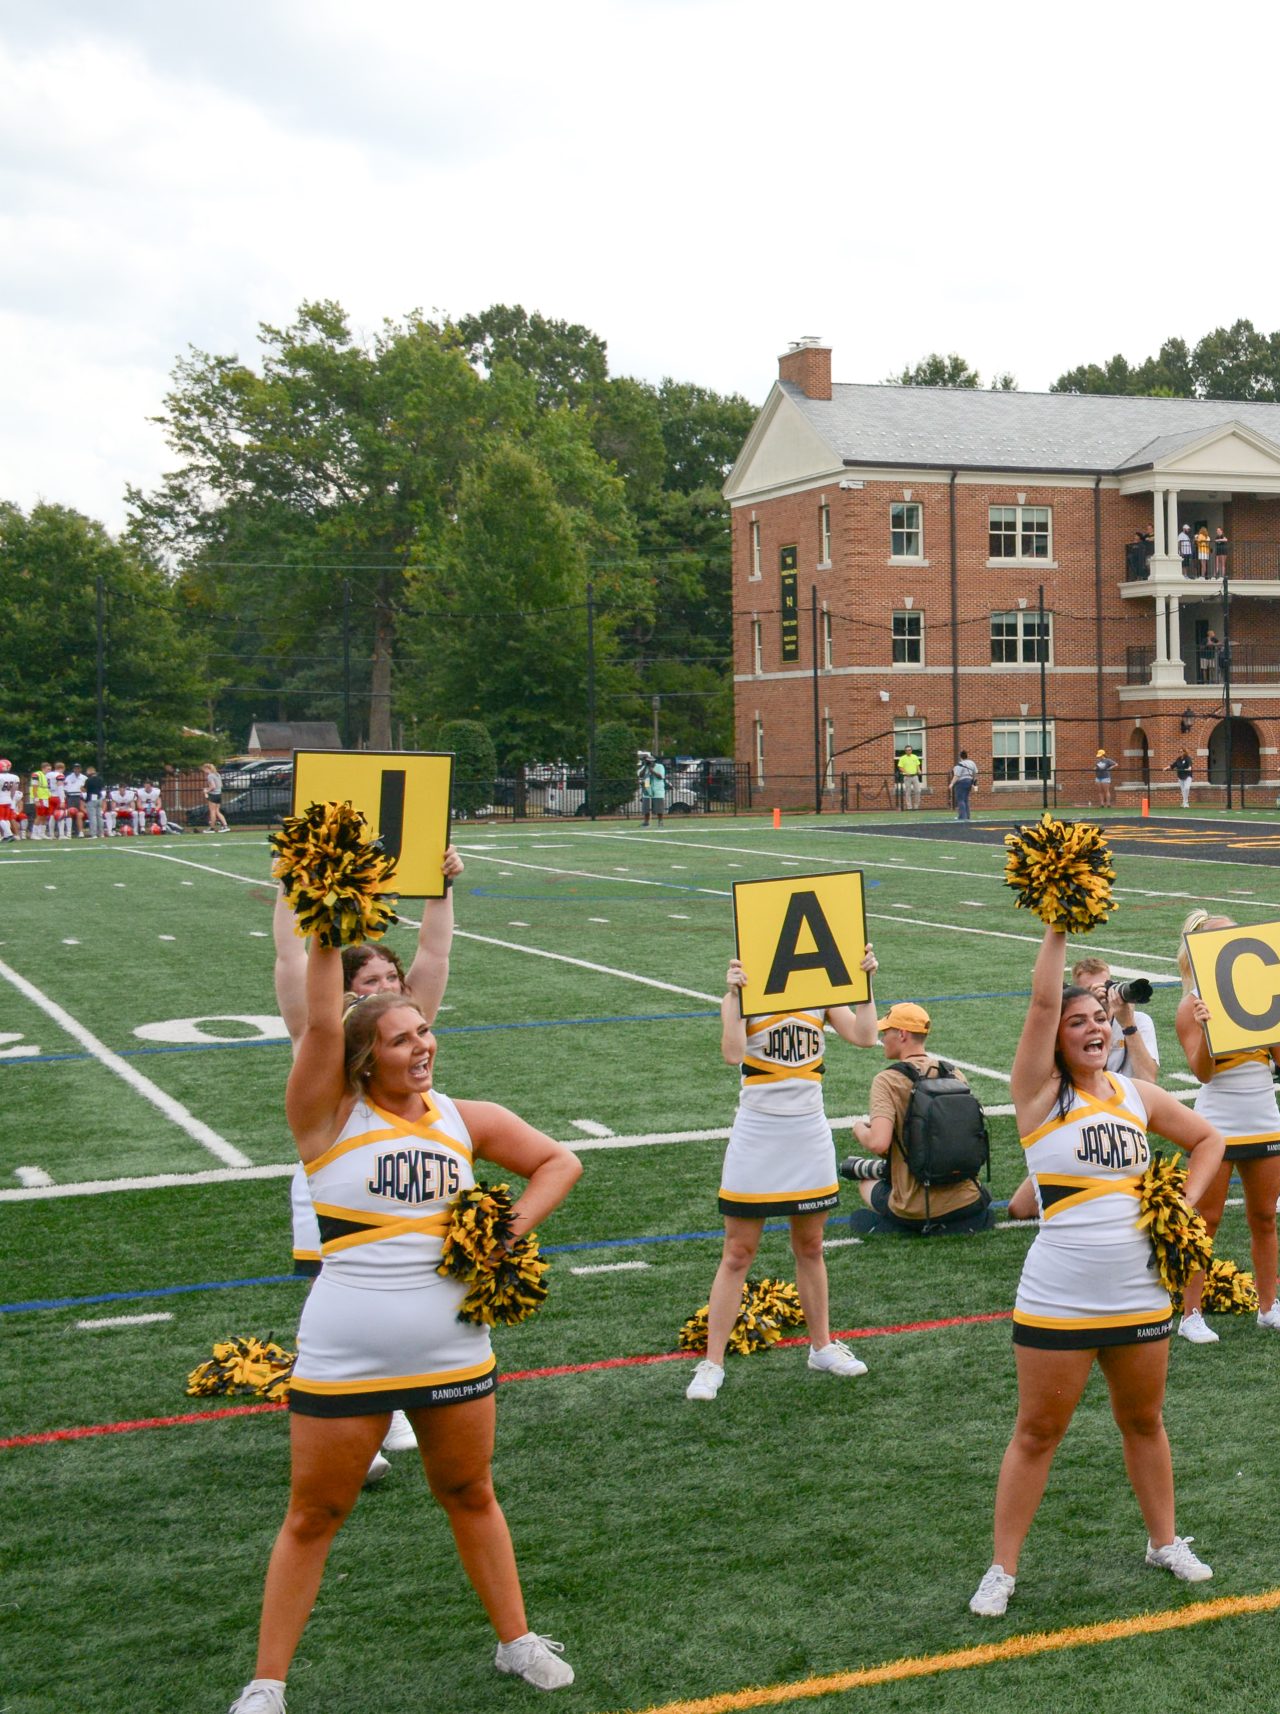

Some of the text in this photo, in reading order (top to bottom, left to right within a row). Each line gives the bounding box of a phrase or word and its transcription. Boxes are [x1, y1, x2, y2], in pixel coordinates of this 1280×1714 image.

[763, 890, 854, 996] A
[763, 1024, 820, 1062] JACKETS
[1076, 1122, 1148, 1169] JACKETS
[367, 1149, 461, 1204] JACKETS
